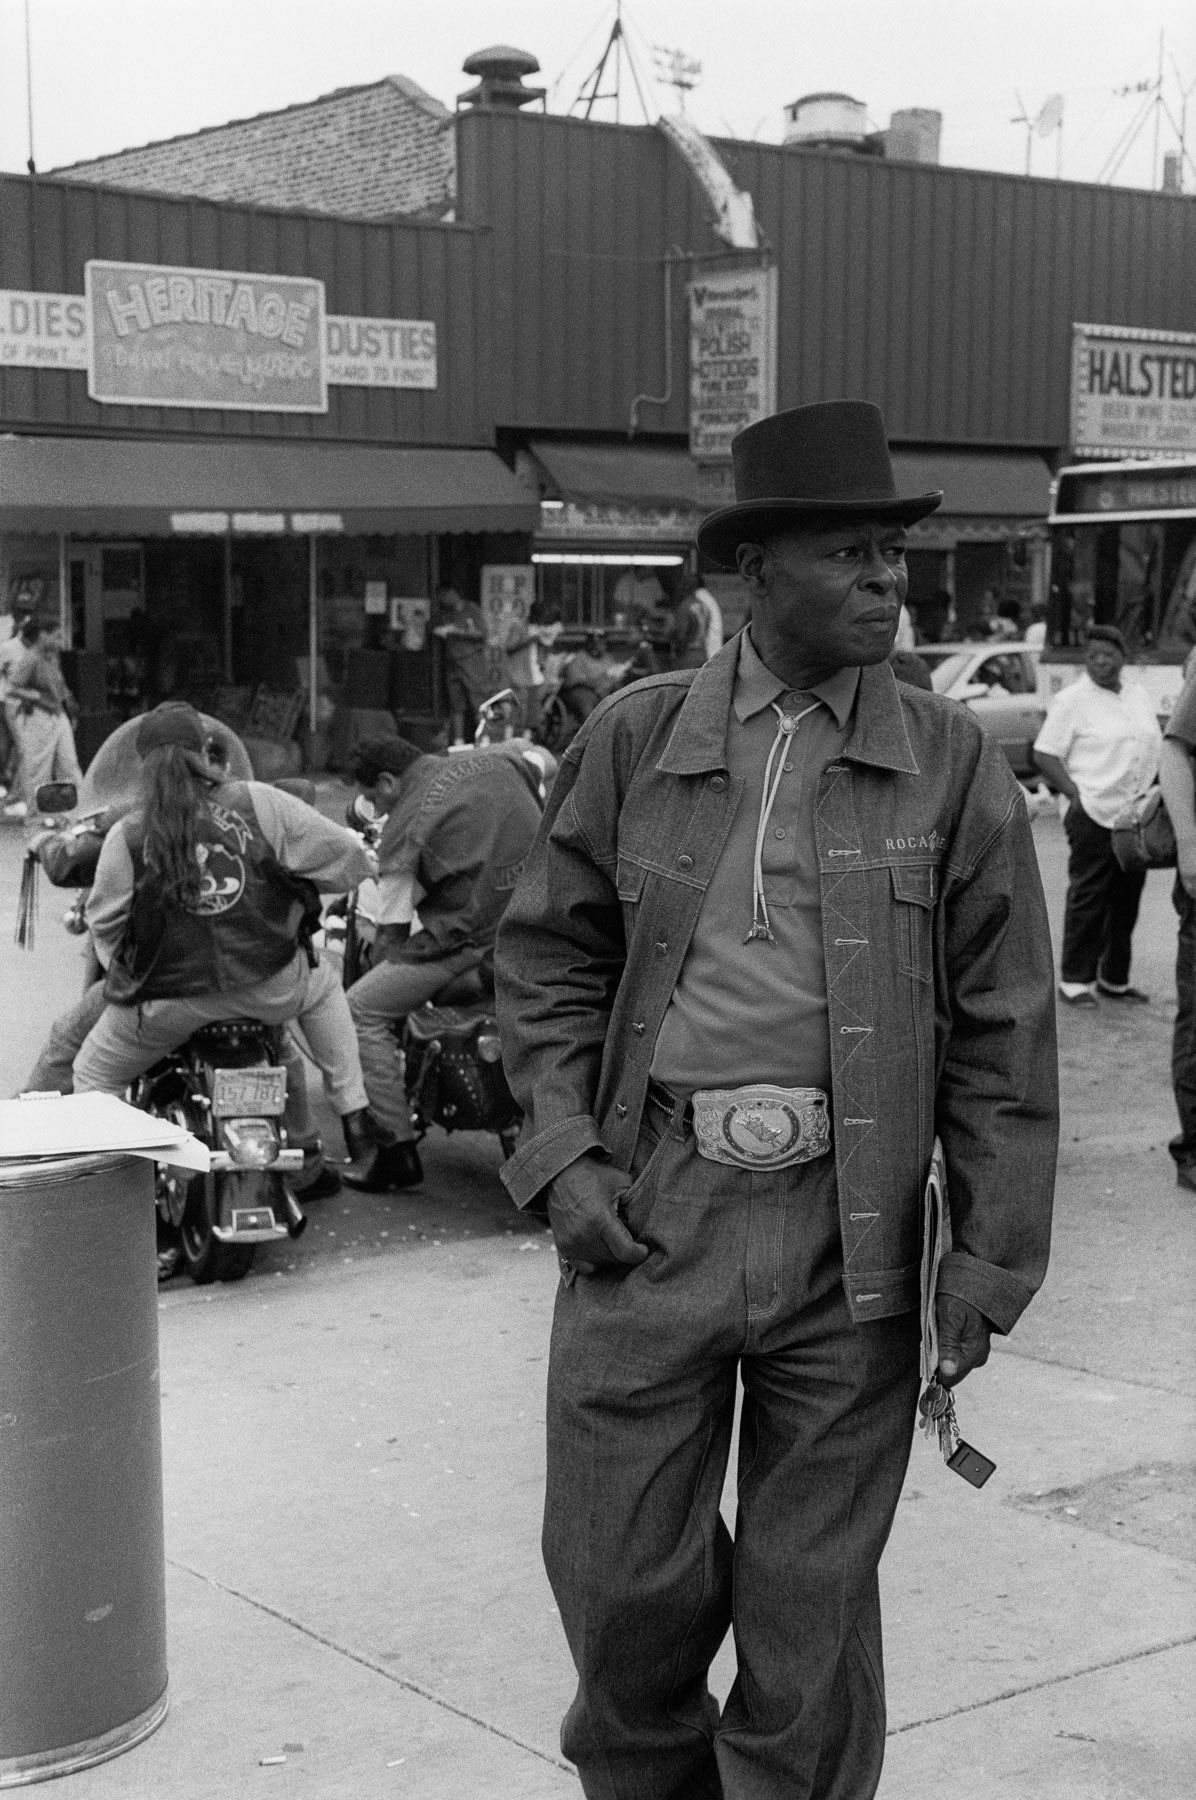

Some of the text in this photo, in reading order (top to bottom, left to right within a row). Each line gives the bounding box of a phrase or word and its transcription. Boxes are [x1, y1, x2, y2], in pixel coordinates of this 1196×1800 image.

[0, 298, 86, 339] DIES
[106, 276, 311, 348] HERITAGE
[327, 321, 435, 361] DUSTIES
[1089, 350, 1196, 399] HALSTED
